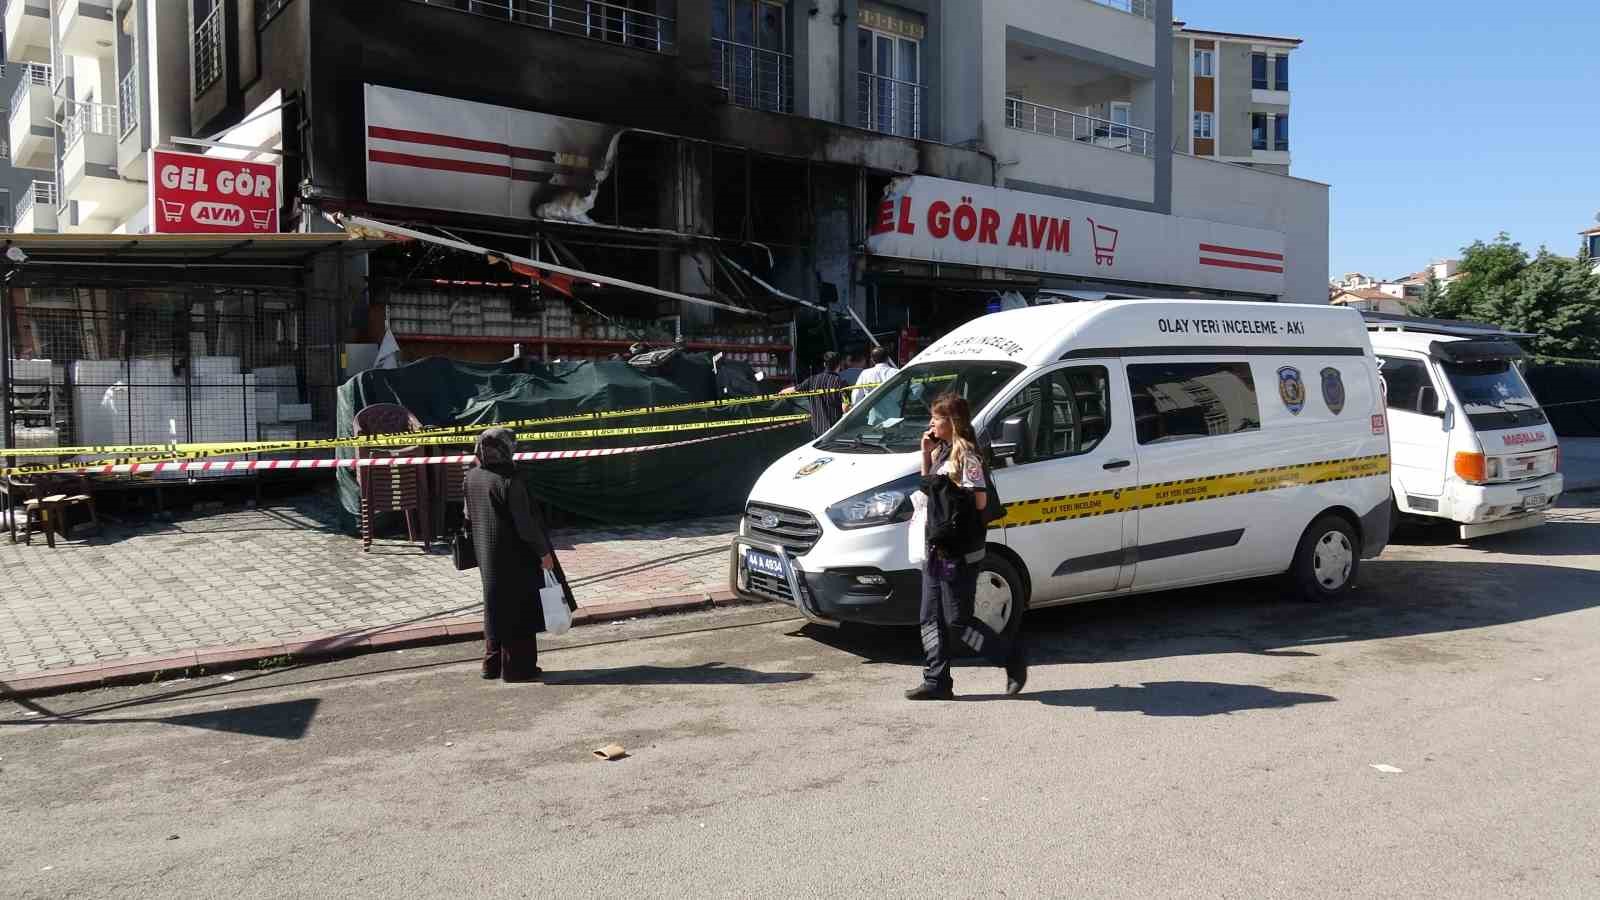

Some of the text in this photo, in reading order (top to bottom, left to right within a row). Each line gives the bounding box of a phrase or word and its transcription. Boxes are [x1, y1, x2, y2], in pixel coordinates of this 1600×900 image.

[161, 164, 272, 198] GEL GÖR
[196, 206, 240, 223] AVM
[927, 196, 1001, 245] GÖR
[1007, 212, 1071, 253] AVM
[1158, 318, 1189, 333] OLAY
